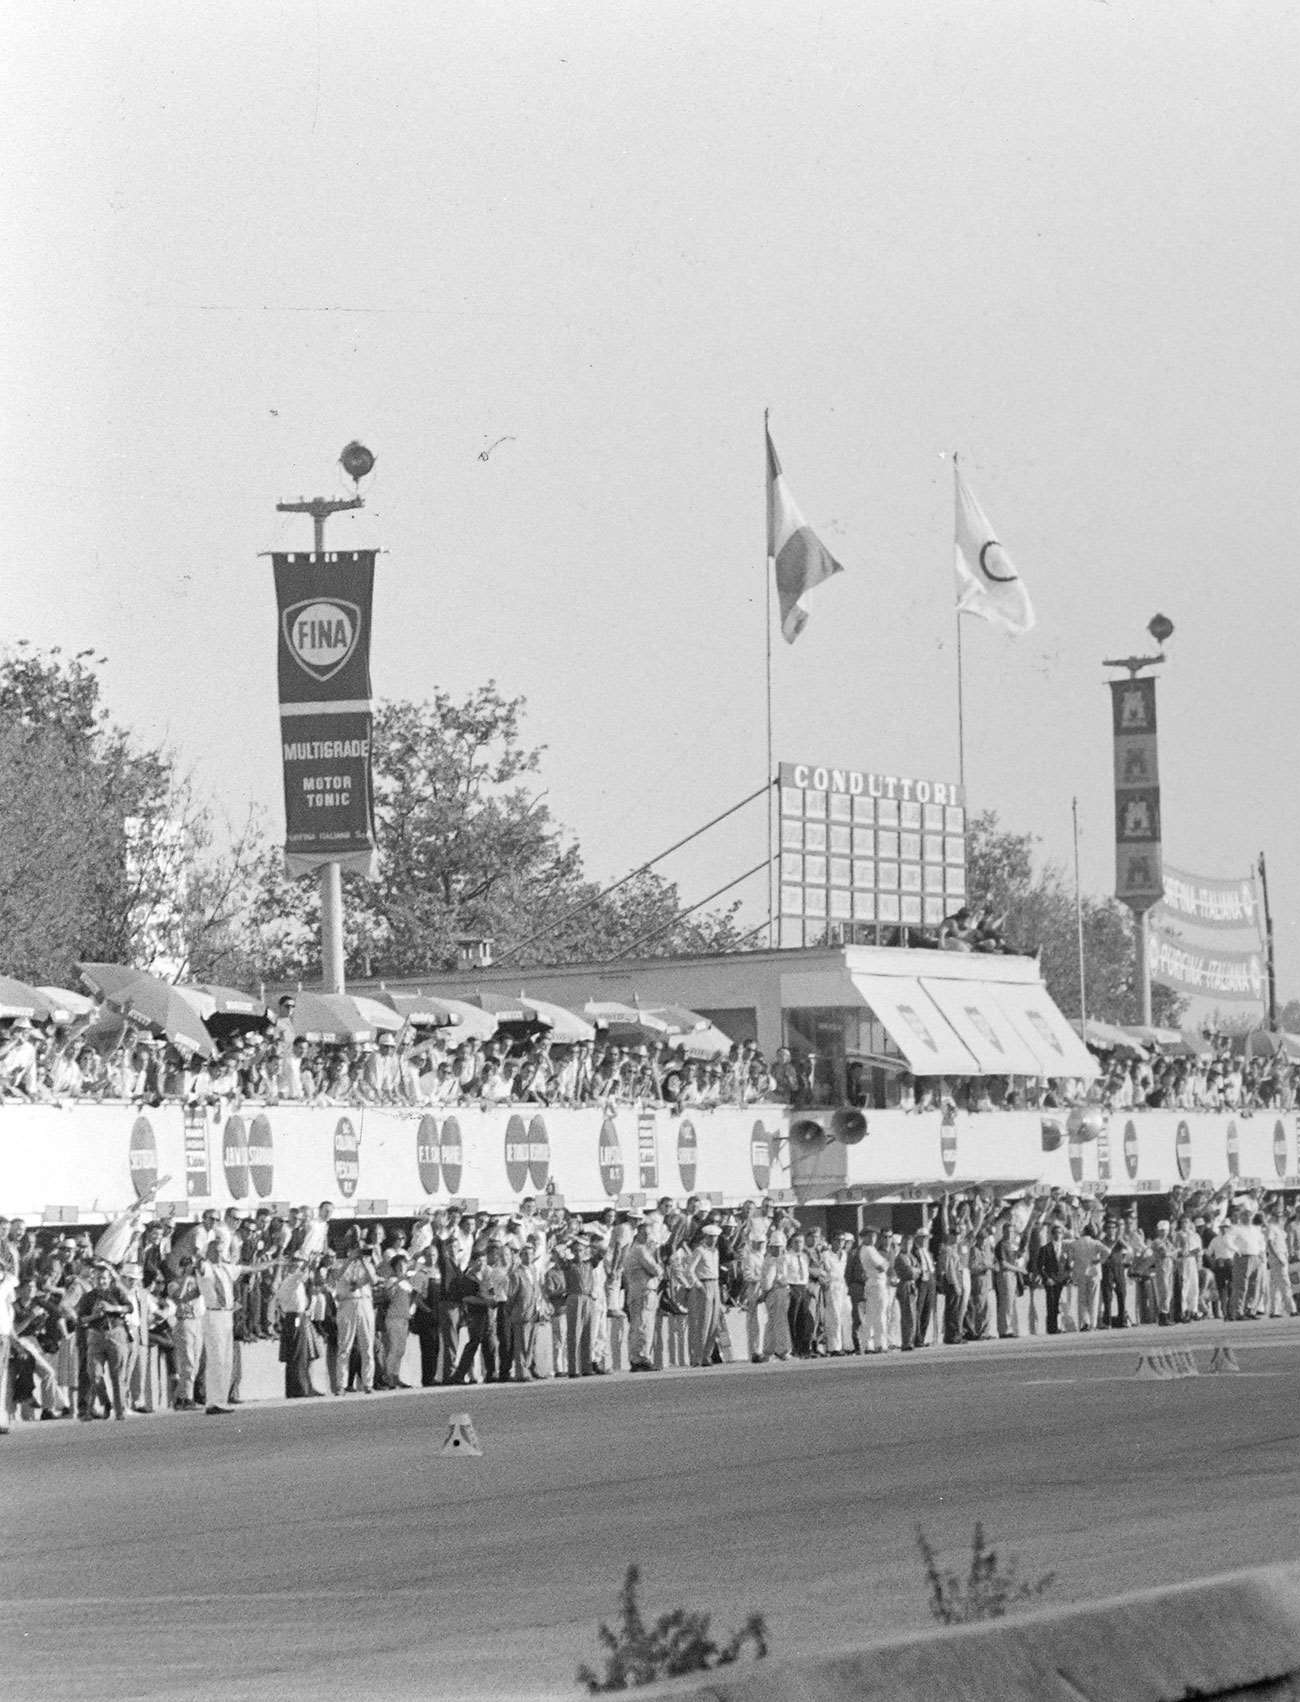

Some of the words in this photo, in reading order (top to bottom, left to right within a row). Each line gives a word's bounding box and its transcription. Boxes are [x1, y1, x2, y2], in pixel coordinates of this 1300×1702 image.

[298, 618, 348, 650] FINA
[284, 739, 369, 761] MULTIGRADE
[303, 776, 352, 791] MOTOR
[795, 765, 957, 806] CONDUTTORI
[306, 793, 350, 808] TONIC
[168, 1203, 176, 1217] 2
